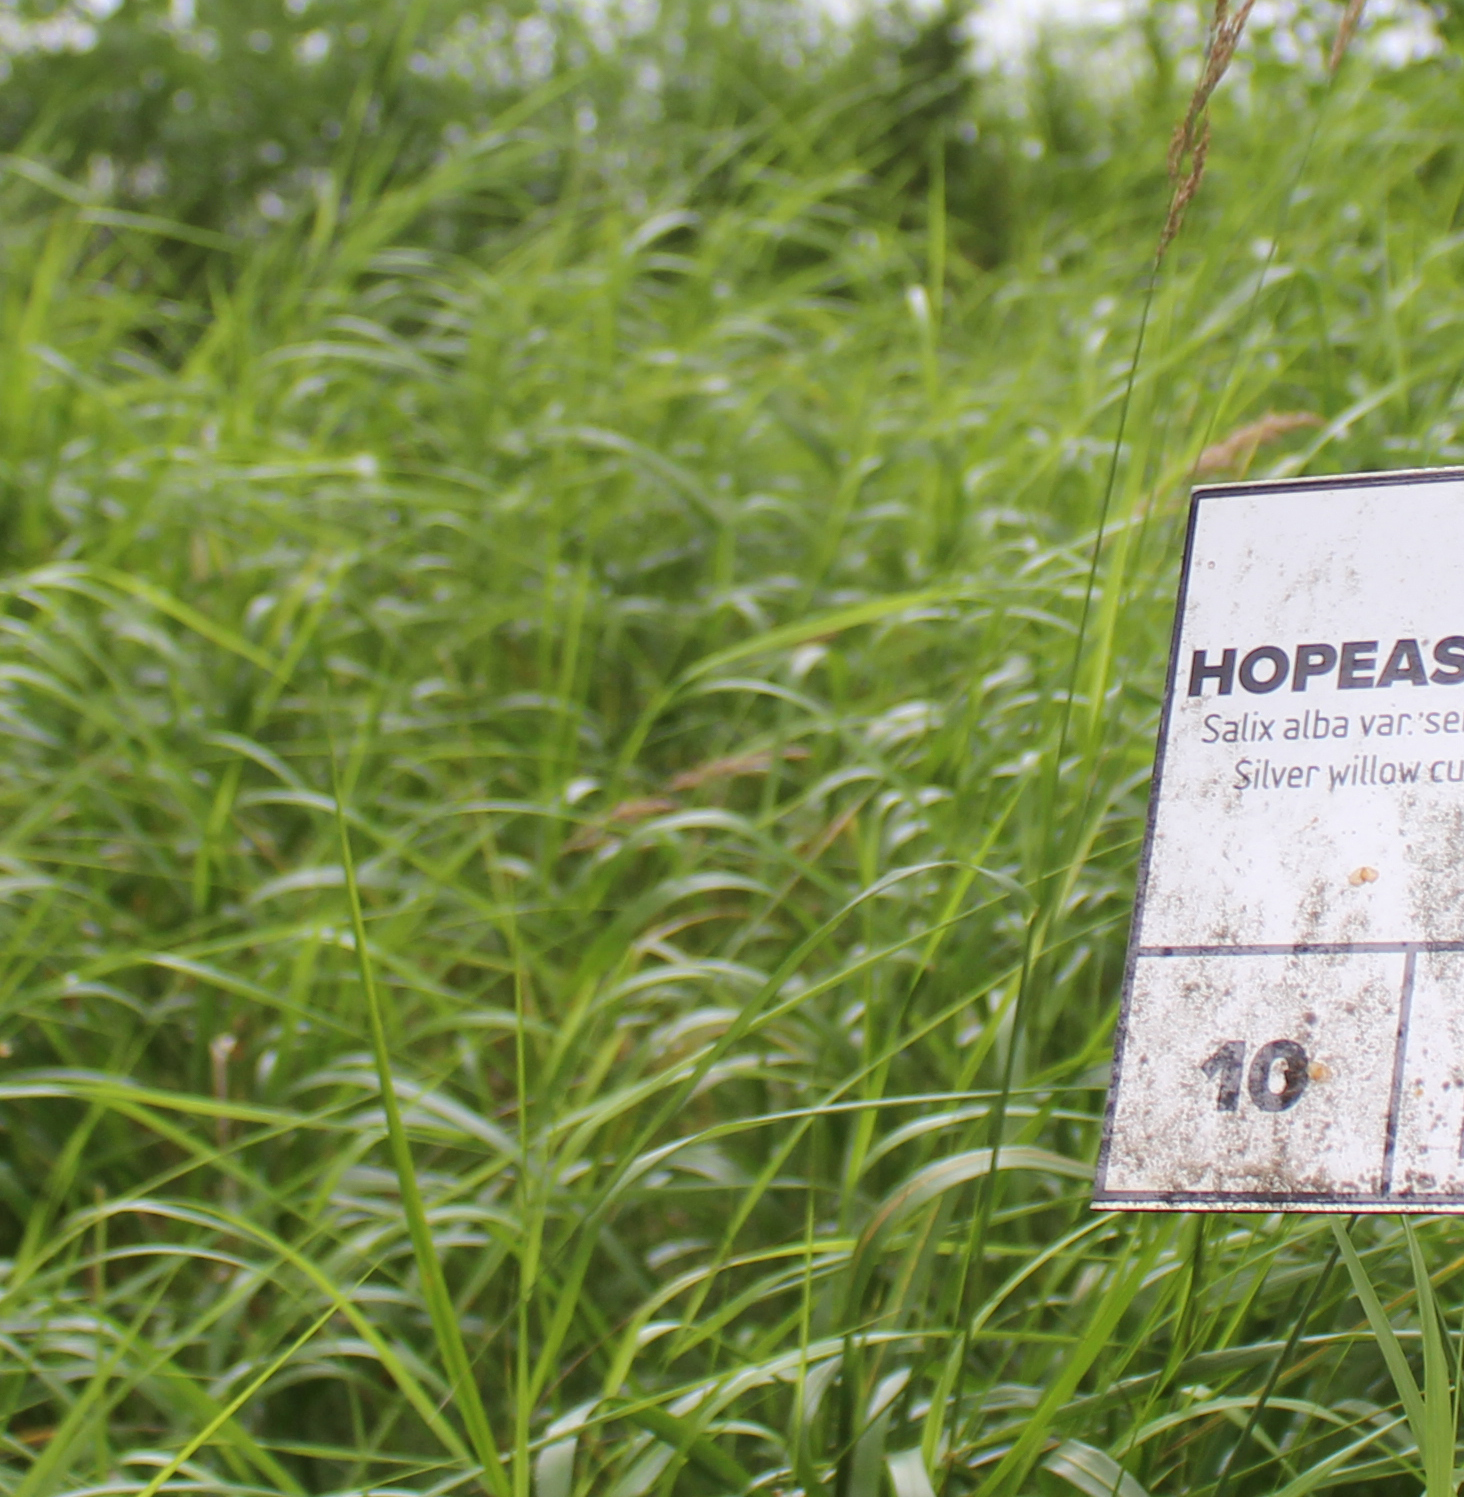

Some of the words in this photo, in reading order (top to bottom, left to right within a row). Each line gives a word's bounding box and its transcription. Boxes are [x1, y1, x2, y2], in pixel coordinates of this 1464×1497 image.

[1201, 713, 1275, 744] Salix
[1283, 709, 1349, 741] alba
[1360, 712, 1413, 738] var.
[1233, 758, 1321, 791] Silver
[1328, 753, 1421, 789] willow
[1201, 1038, 1310, 1113] 10
